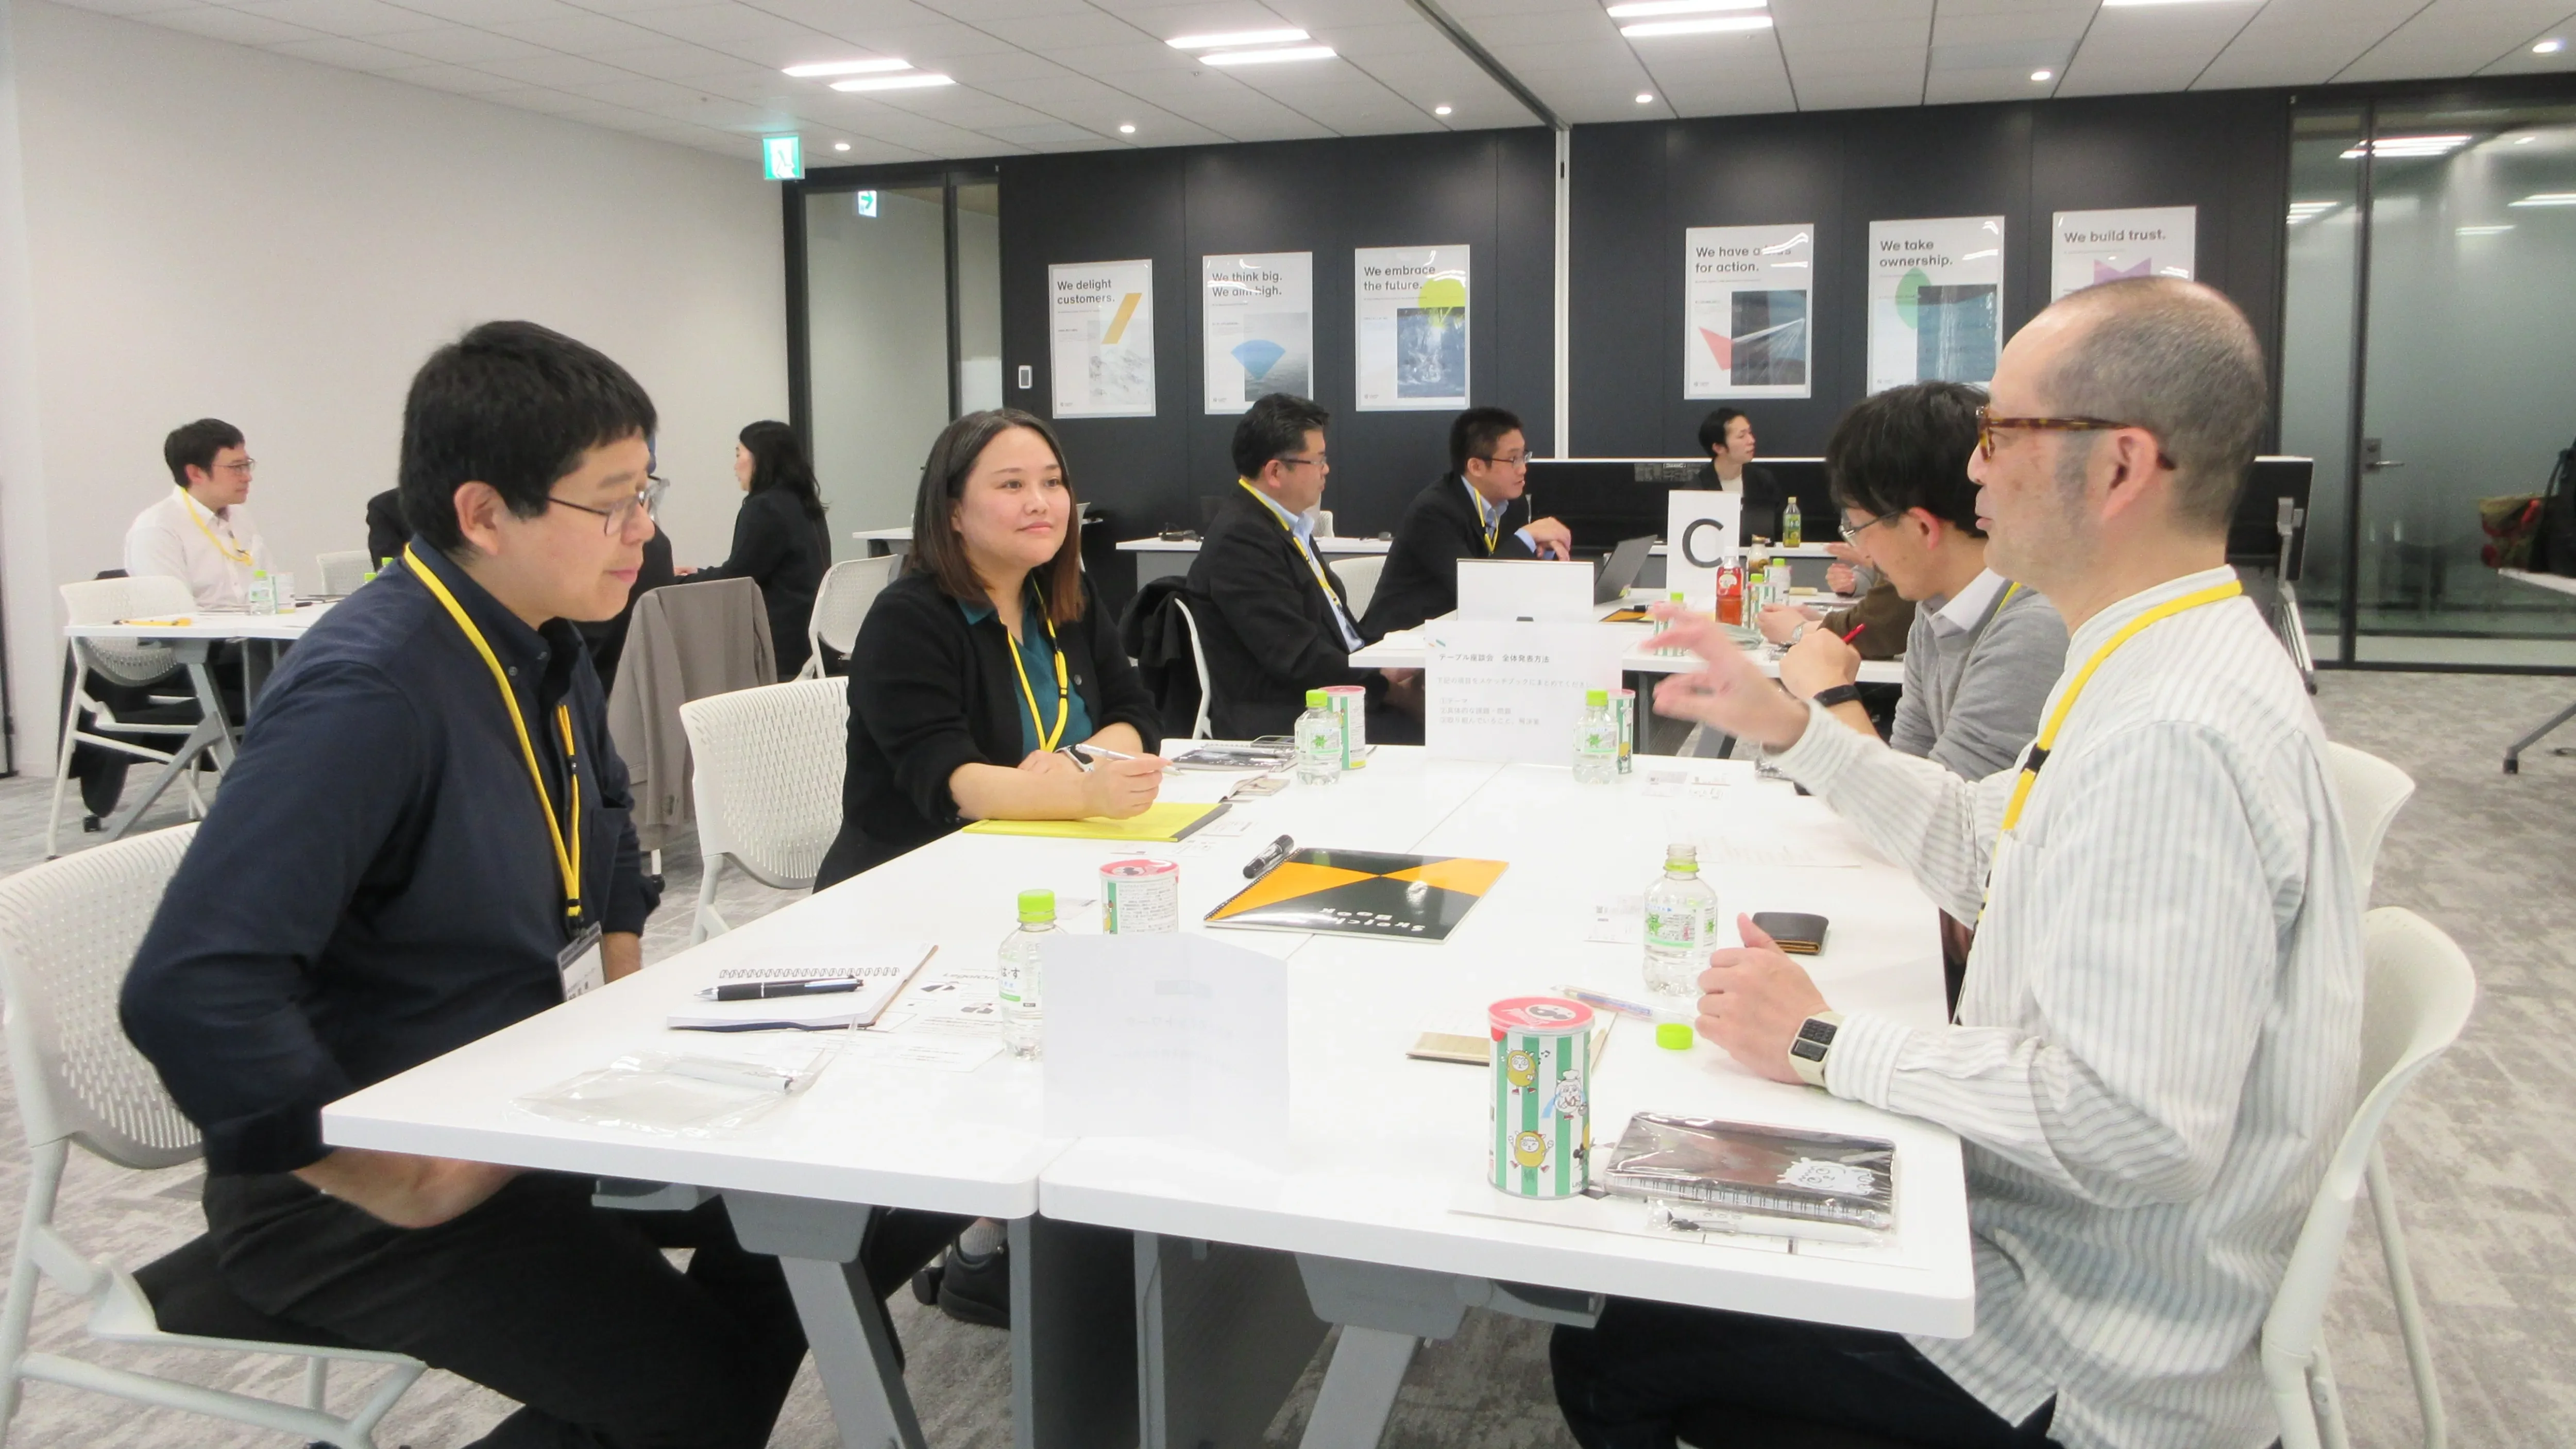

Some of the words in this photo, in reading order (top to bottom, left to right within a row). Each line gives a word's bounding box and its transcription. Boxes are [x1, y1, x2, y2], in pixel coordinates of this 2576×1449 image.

[2064, 232, 2086, 243] We
[2090, 230, 2124, 242] build
[2129, 229, 2166, 240] trust.
[1880, 240, 1901, 251] We
[1905, 239, 1934, 250] take
[1696, 247, 1715, 258] We
[1719, 246, 1749, 257] have
[1753, 248, 1760, 256] a
[1696, 262, 1712, 273] for
[1716, 261, 1759, 273] action.
[1879, 255, 1953, 267] ownership.
[1364, 266, 1381, 276] We
[1385, 265, 1435, 276] embrace
[1212, 273, 1229, 281] We
[1232, 272, 1259, 281] think
[1262, 271, 1282, 283] big.
[1057, 281, 1073, 291] We
[1076, 279, 1111, 291] delight
[1364, 281, 1382, 291] the
[1385, 280, 1422, 290] future.
[1212, 287, 1229, 297] We
[1057, 294, 1115, 305] customers.
[1682, 518, 1724, 568] C
